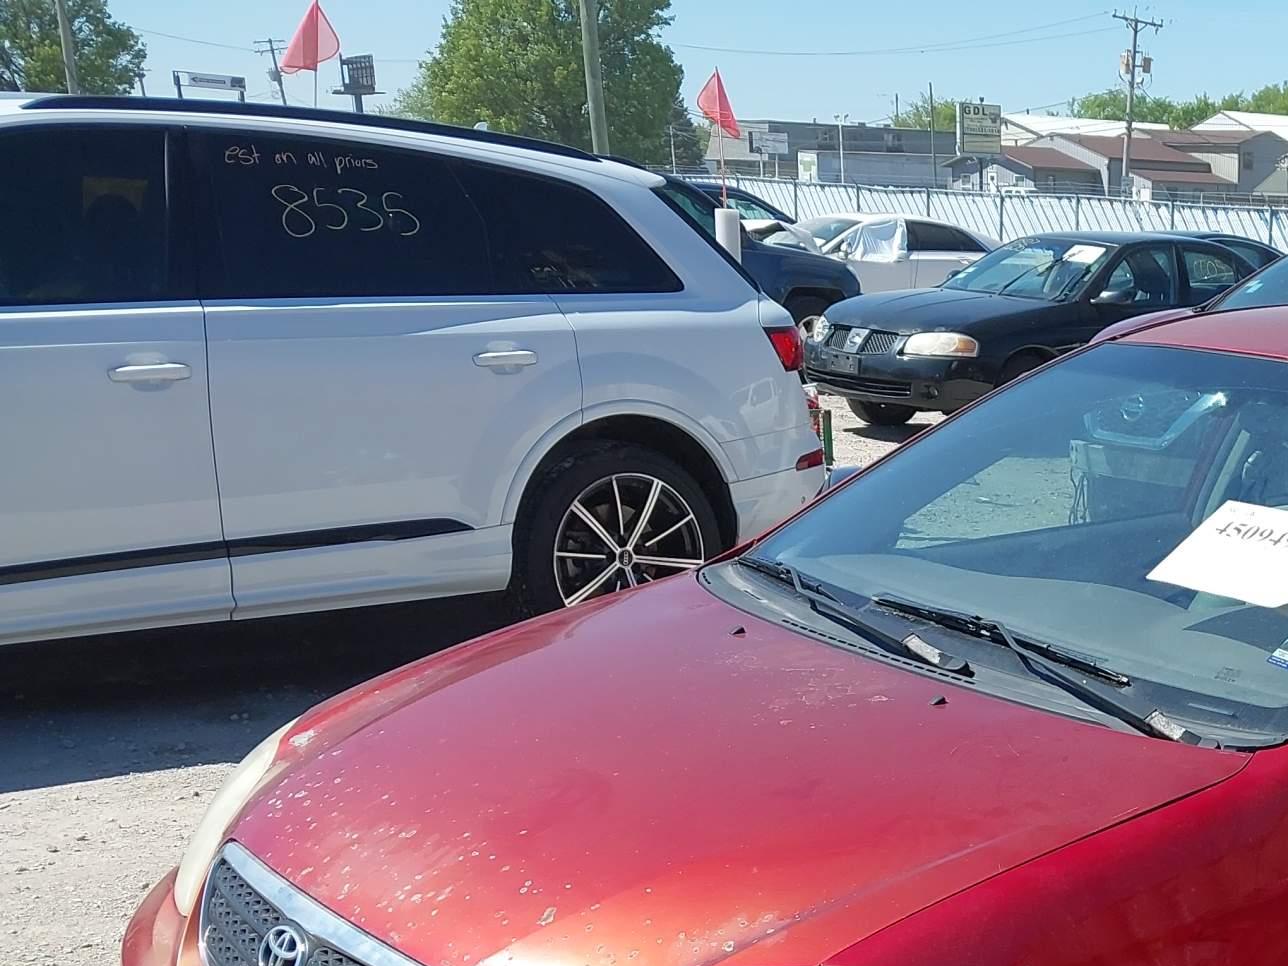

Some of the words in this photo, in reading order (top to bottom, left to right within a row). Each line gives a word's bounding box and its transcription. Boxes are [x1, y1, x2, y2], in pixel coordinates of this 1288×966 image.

[964, 105, 988, 116] GDL
[224, 144, 261, 165] est
[274, 151, 297, 165] on
[307, 151, 328, 168] all
[271, 184, 420, 238] 8535
